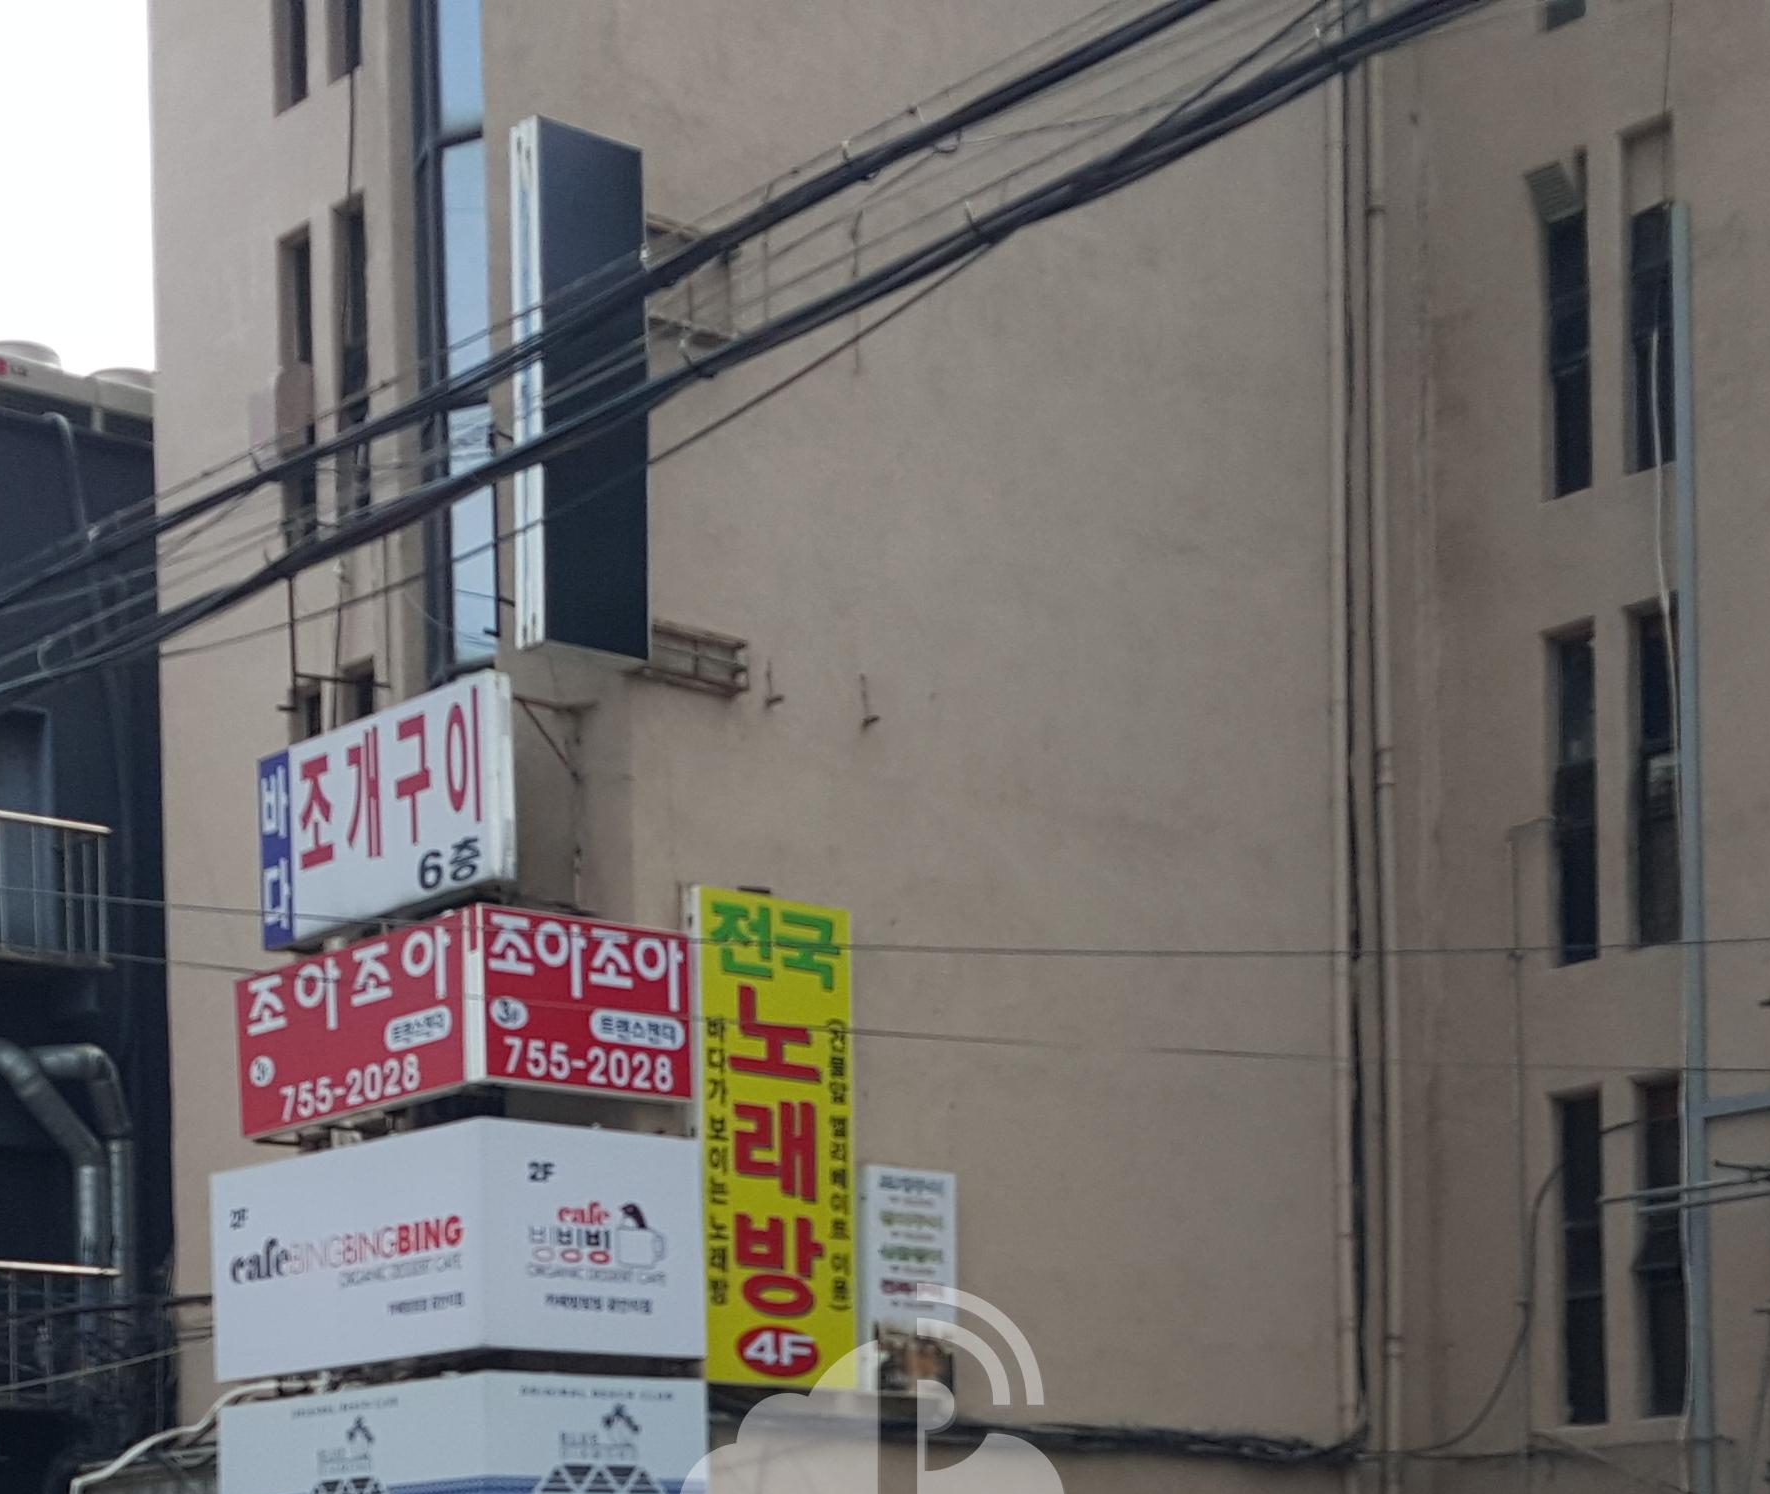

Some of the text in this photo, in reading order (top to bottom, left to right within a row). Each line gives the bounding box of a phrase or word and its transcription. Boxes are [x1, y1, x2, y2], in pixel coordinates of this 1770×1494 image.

[260, 685, 483, 930] 바다 조개구이
[418, 836, 482, 891] 6층
[488, 912, 685, 1013] 조아조아
[711, 902, 841, 992] 전국
[247, 925, 452, 1037] 조아조아
[279, 1053, 422, 1122] 755-2028
[504, 1036, 675, 1093] 755-2028
[528, 1162, 554, 1182] 2F
[728, 982, 829, 1319] 노래방
[528, 1225, 612, 1265] 빙빙빙
[557, 1201, 611, 1226] cafe
[743, 1330, 816, 1367] 4F
